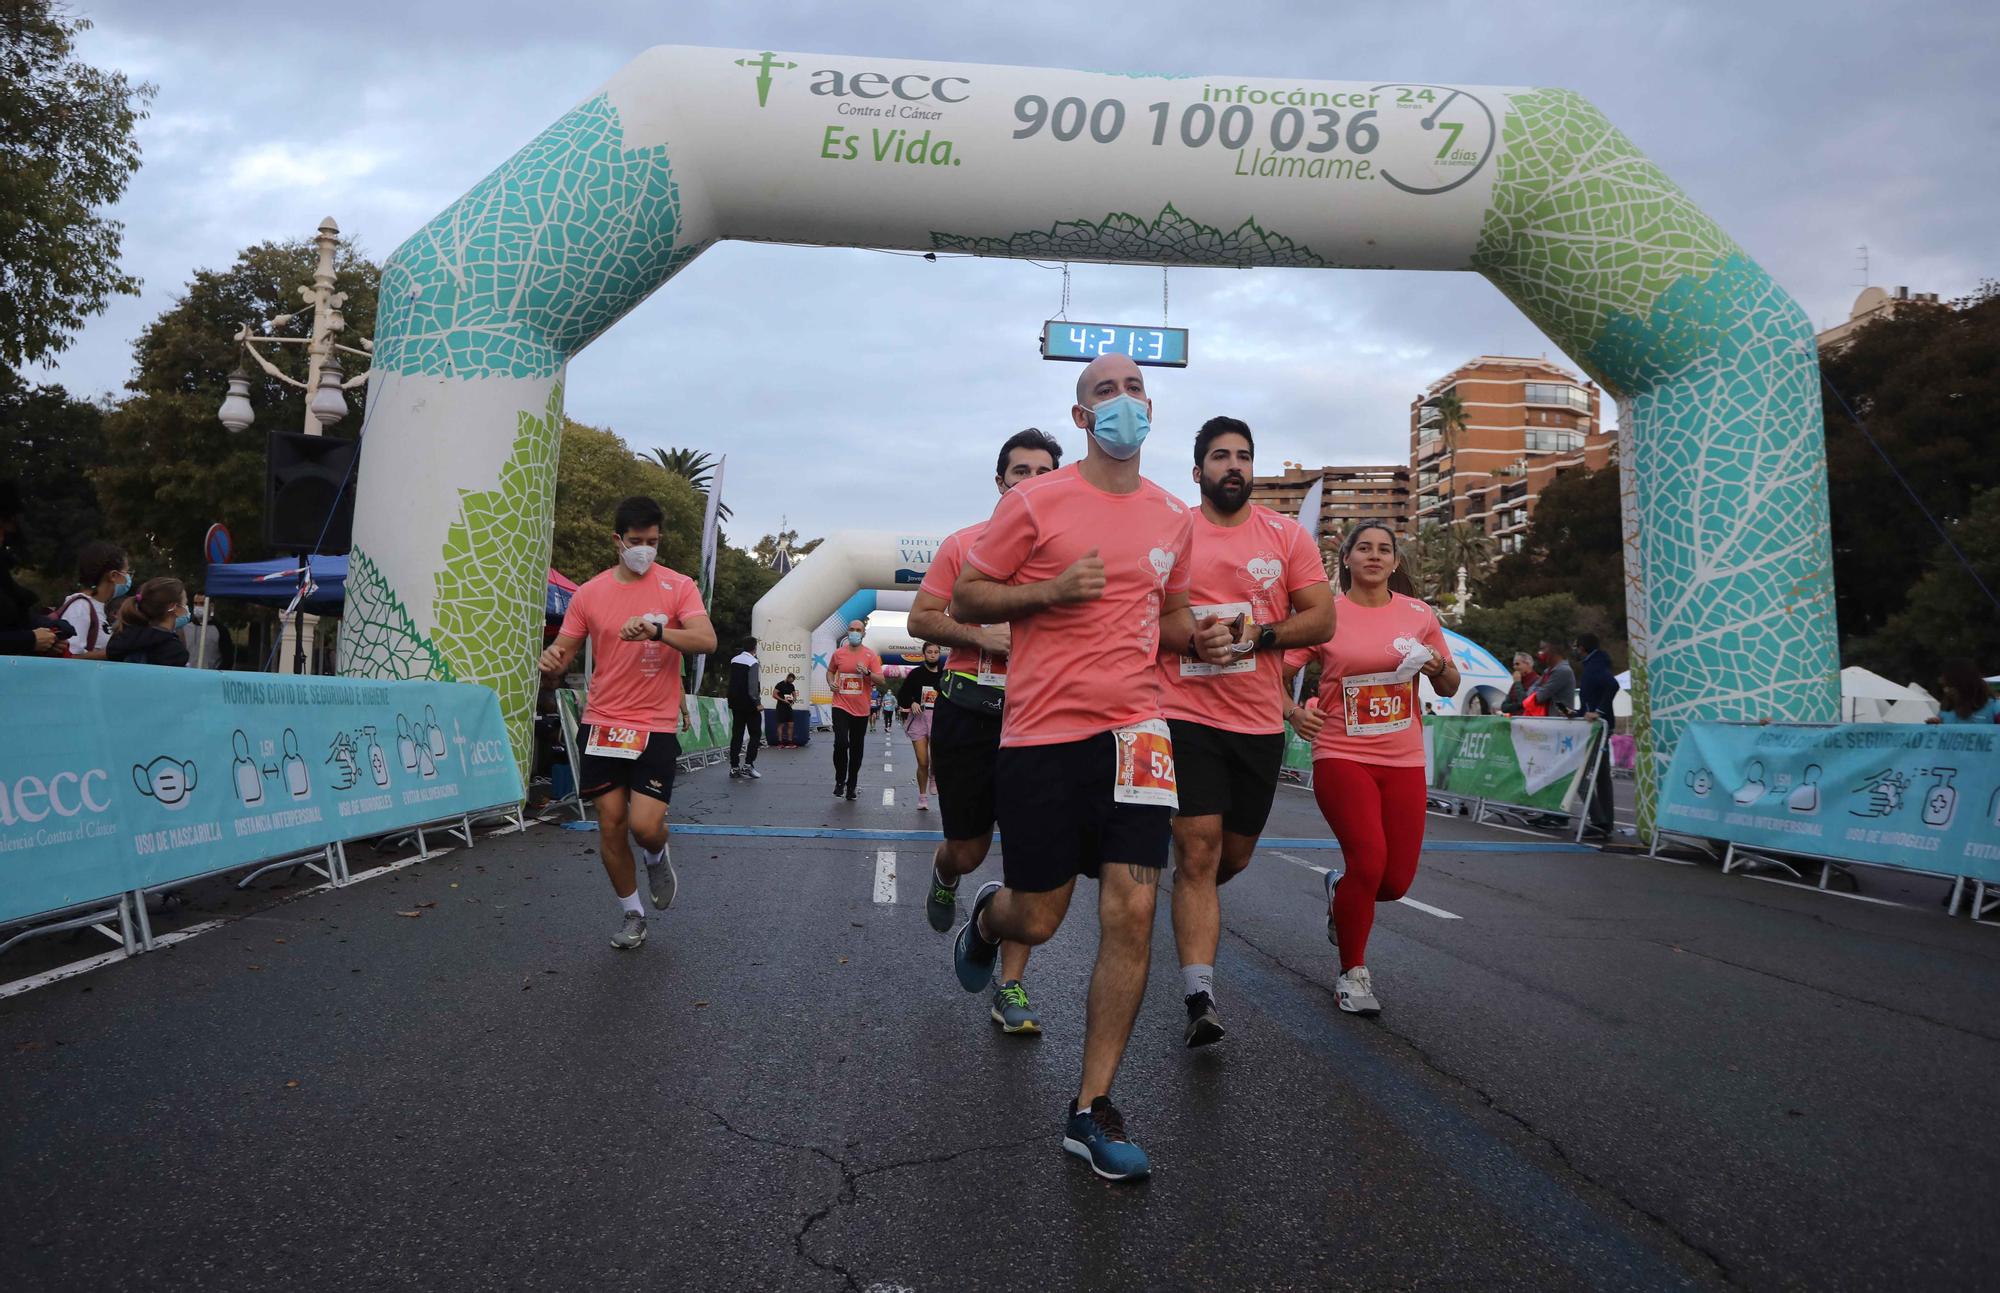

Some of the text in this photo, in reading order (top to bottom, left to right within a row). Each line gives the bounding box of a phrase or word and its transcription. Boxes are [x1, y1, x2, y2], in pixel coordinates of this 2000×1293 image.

[809, 69, 971, 104] aecc
[1202, 84, 1380, 108] infocáncer
[1396, 88, 1437, 104] 24
[837, 101, 942, 121] Contra el Cáncer
[1012, 94, 1380, 154] 900 100 036
[820, 125, 961, 167] Es Vida.
[1435, 122, 1465, 159] 7
[1234, 147, 1376, 180] Llámame.
[1251, 566, 1281, 577] aecc
[761, 641, 801, 652] València
[222, 680, 265, 705] NORMAS
[267, 683, 296, 705] COVID
[297, 683, 309, 705] DE
[310, 684, 355, 706] SEGURIDAD
[1369, 695, 1402, 718] 530
[607, 727, 638, 744] 528
[1458, 732, 1491, 759] AECC
[1938, 732, 1994, 752] HIGIENE
[470, 739, 505, 765] aecc
[1151, 751, 1174, 782] 52
[36, 827, 74, 847] Contra
[75, 821, 85, 841] el
[85, 821, 118, 839] Cáncer
[134, 821, 223, 855] USO DE MASCARILLA
